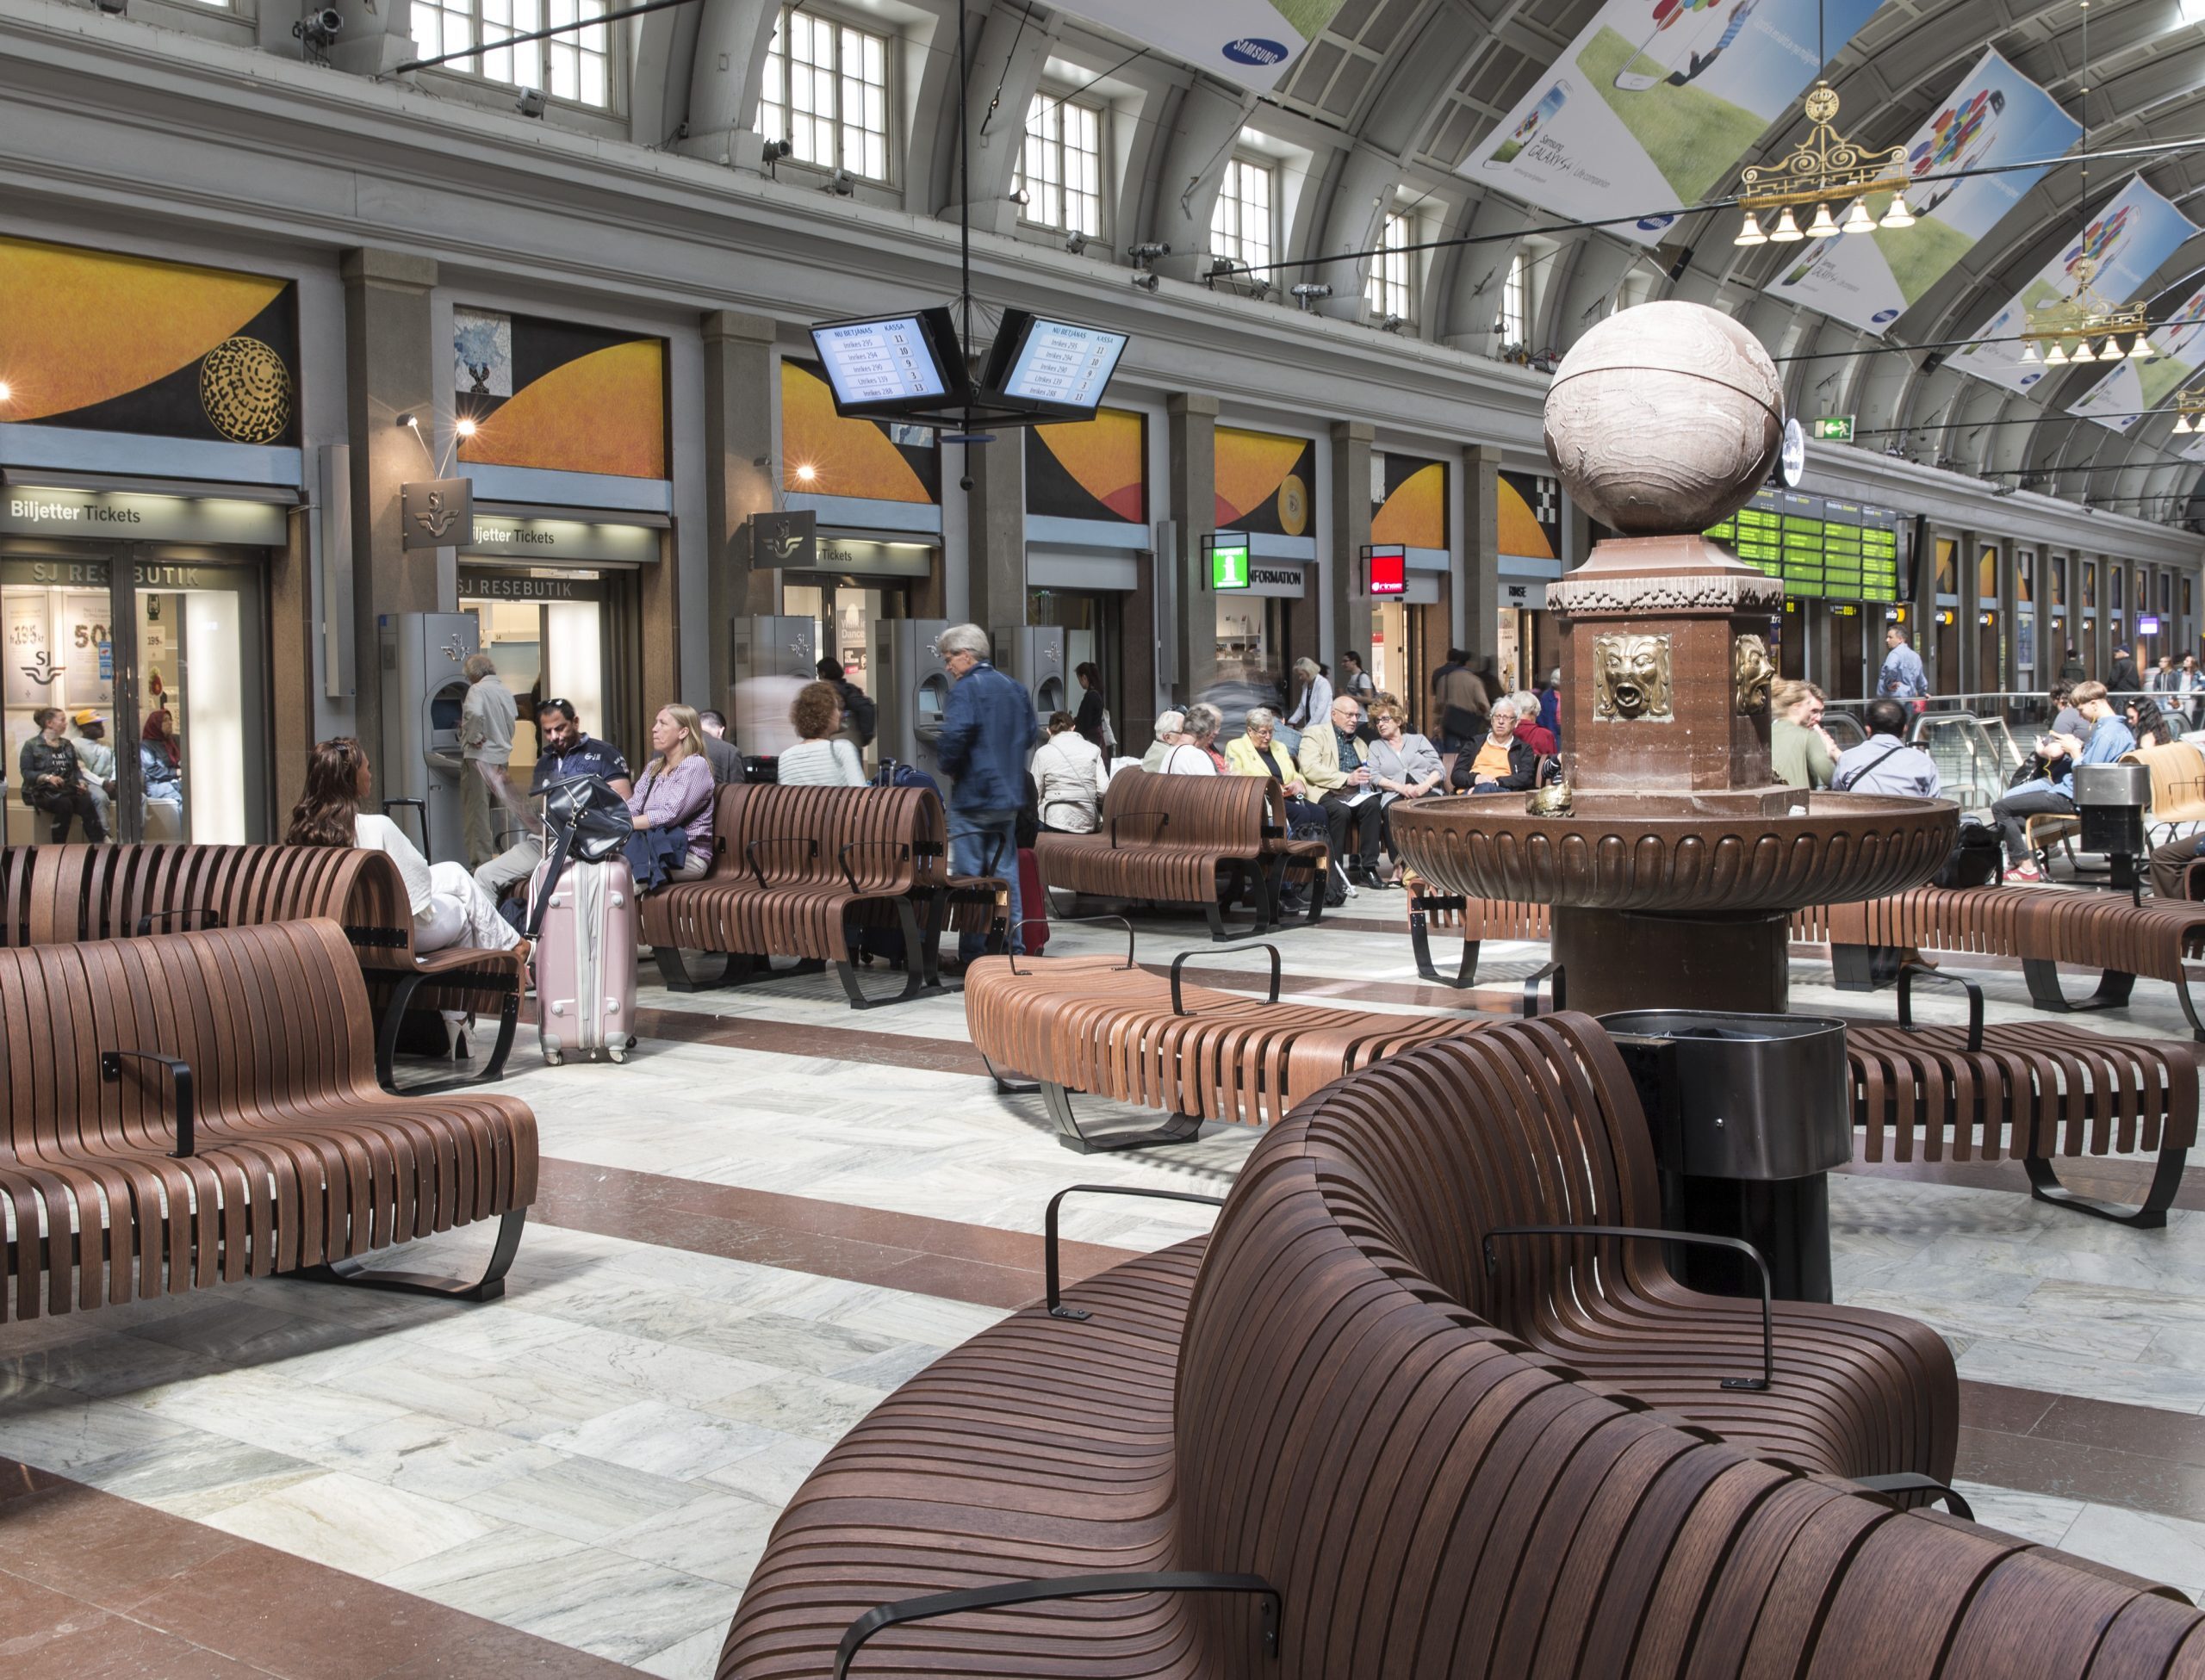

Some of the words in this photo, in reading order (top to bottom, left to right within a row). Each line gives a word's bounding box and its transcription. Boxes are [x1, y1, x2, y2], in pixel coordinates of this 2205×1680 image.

[1233, 39, 1278, 65] SAMSUNG
[1540, 134, 1564, 153] Samsung
[1528, 145, 1561, 167] GALAXY
[884, 323, 905, 332] KASSA
[894, 334, 904, 343] 11
[899, 347, 909, 356] 10
[428, 490, 444, 513] SJ
[10, 499, 80, 522] Biljetter
[84, 505, 141, 524] Tickets
[472, 526, 512, 544] iljetter
[513, 530, 555, 544] Tickets
[776, 519, 790, 538] SJ
[822, 549, 853, 561] Tickets
[34, 563, 59, 582] SJ
[69, 564, 200, 586] RESBUTIK
[1249, 569, 1301, 586] NFORMATION
[457, 579, 473, 594] SJ
[480, 580, 572, 597] RESEBUTIK
[1508, 586, 1527, 598] RINSE
[841, 618, 860, 629] Walk
[1770, 614, 1781, 624] tra
[75, 623, 111, 648] 50
[842, 629, 865, 639] Dance
[35, 651, 52, 667] SJ
